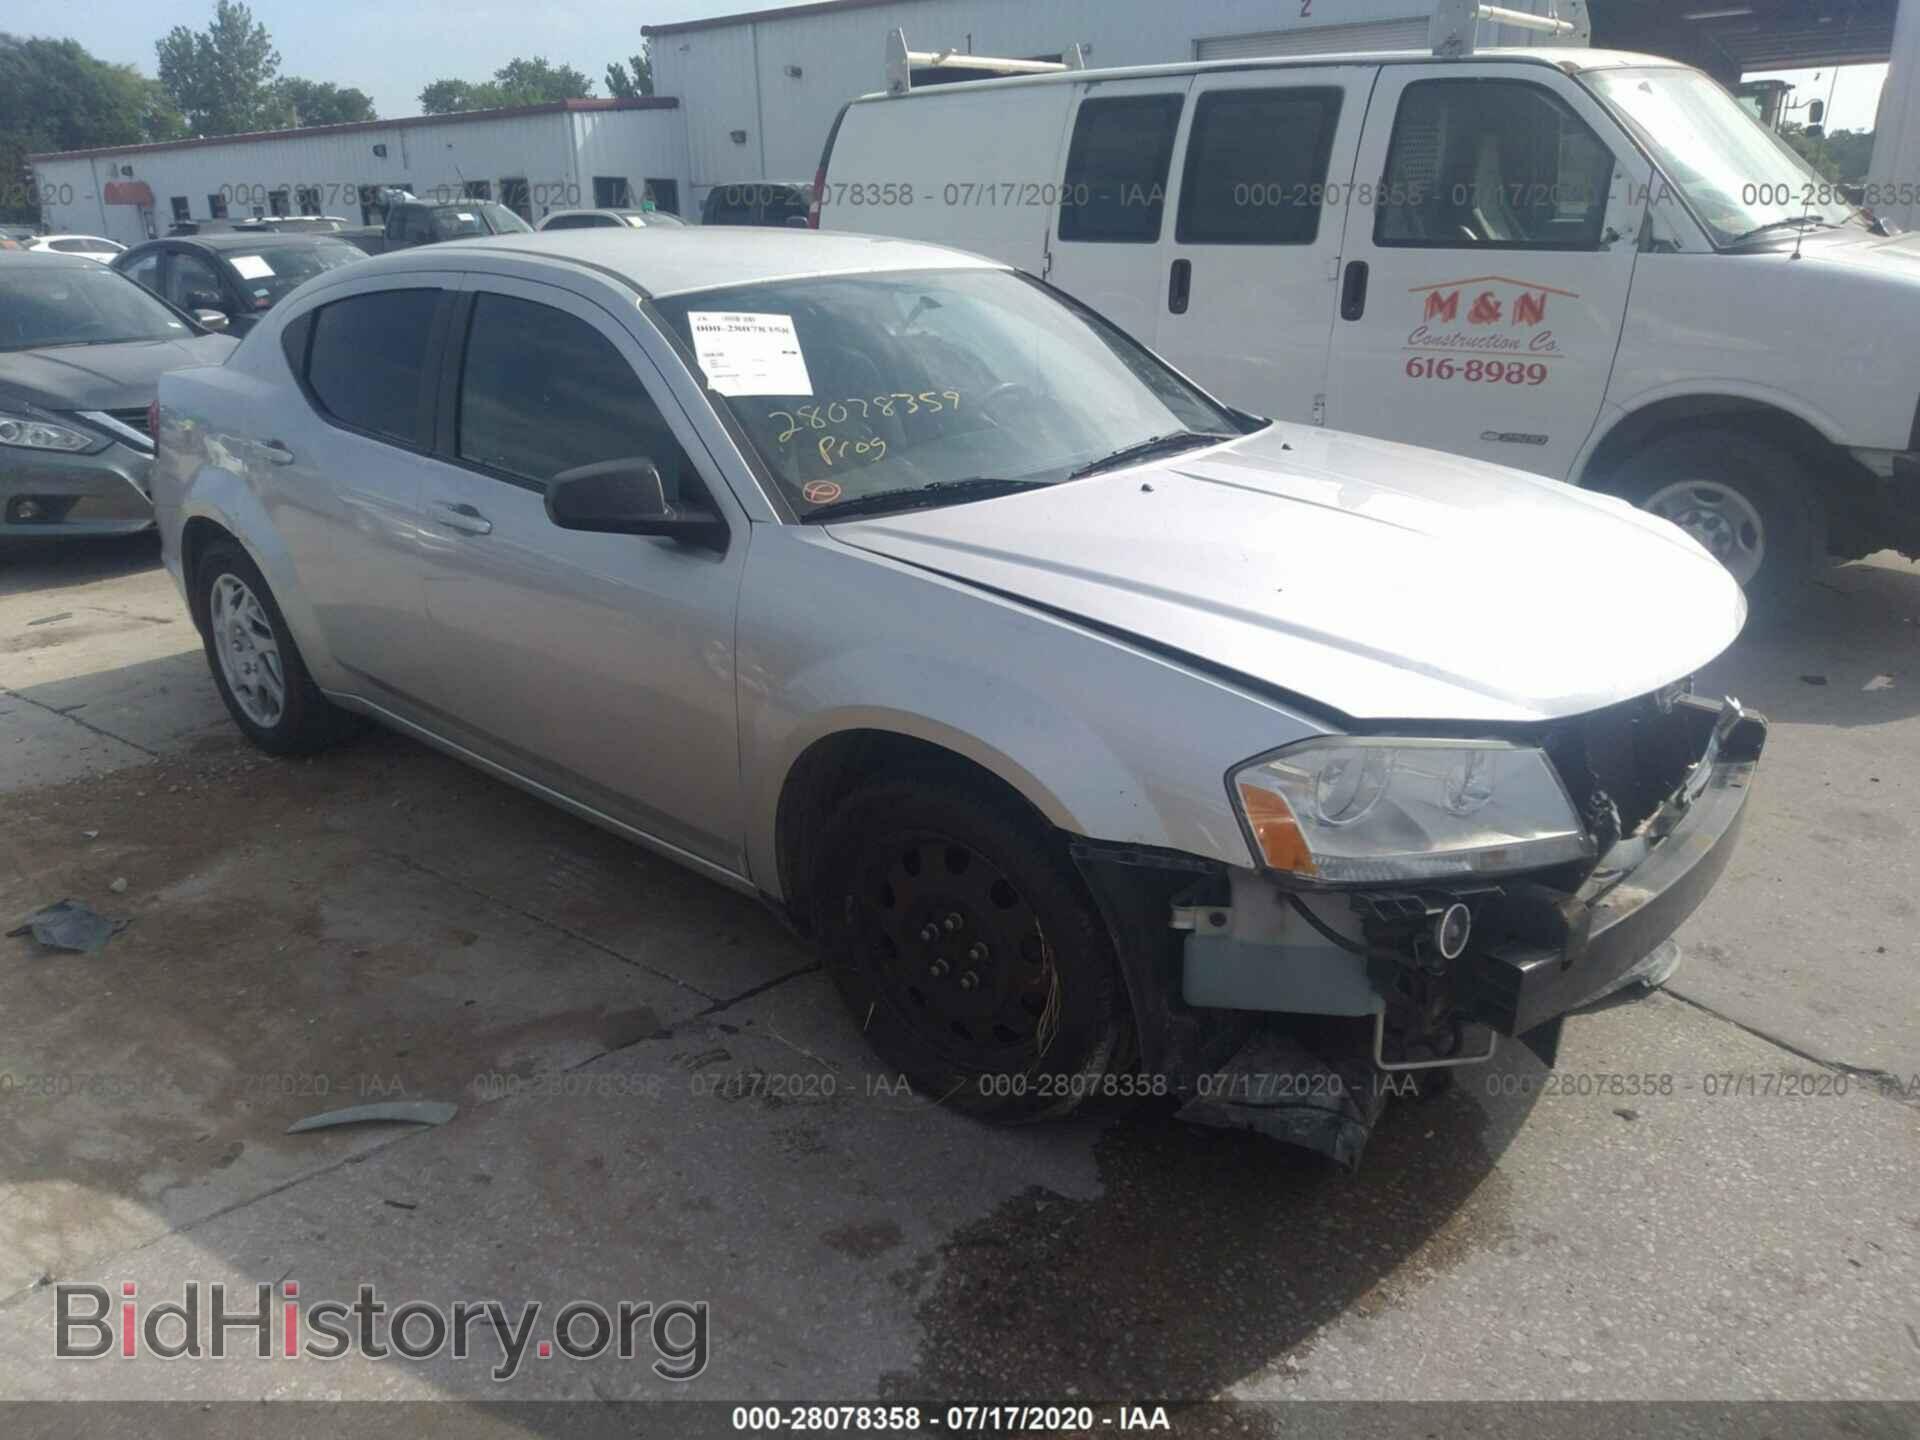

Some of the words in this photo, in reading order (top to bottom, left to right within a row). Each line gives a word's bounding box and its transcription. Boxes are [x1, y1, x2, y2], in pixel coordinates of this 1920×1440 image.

[1299, 0, 1313, 18] 2
[1424, 290, 1460, 323] M
[1467, 291, 1502, 325] &
[1512, 291, 1547, 327] N
[1408, 325, 1521, 350] Construction
[1529, 330, 1561, 352] Co.
[1405, 356, 1548, 386] 616-8989
